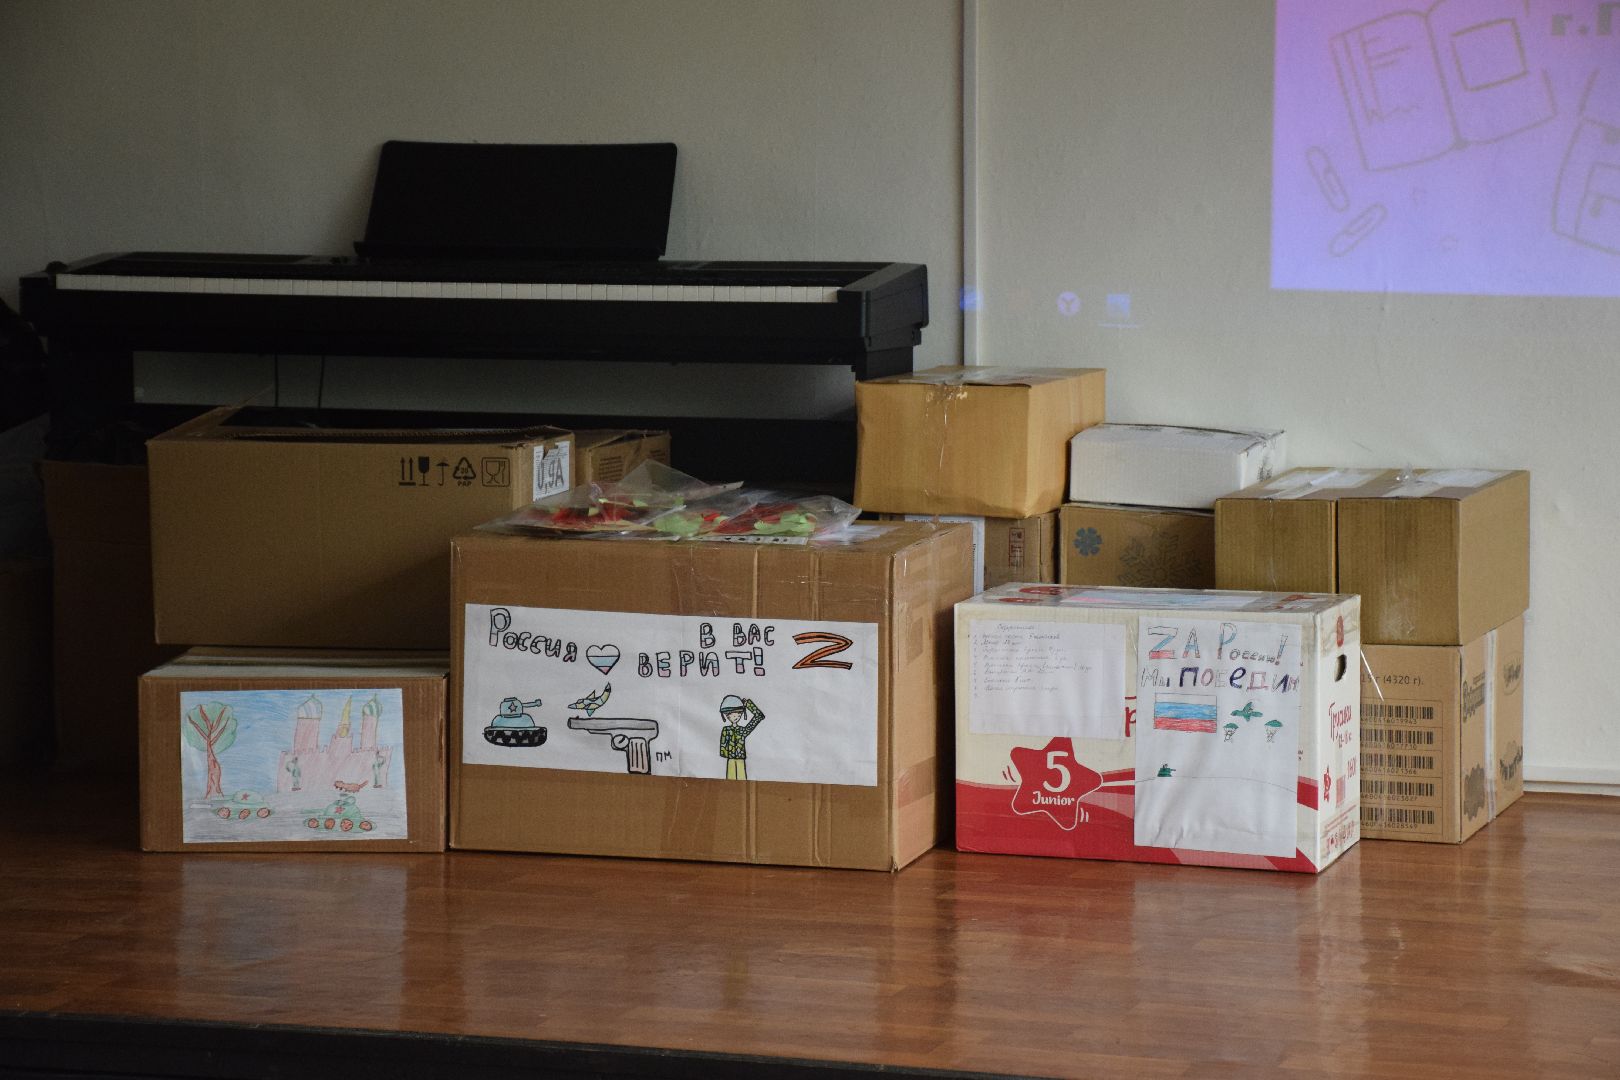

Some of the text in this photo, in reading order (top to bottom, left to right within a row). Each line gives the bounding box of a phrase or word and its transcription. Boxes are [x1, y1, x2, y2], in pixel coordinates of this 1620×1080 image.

[489, 607, 578, 662] Россия
[700, 622, 775, 648] В ВАС
[638, 647, 766, 678] ВЕРИТ!
[791, 631, 854, 671] Z
[1383, 675, 1410, 685] (4320
[1042, 751, 1071, 793] 5
[1032, 790, 1075, 806] Junior
